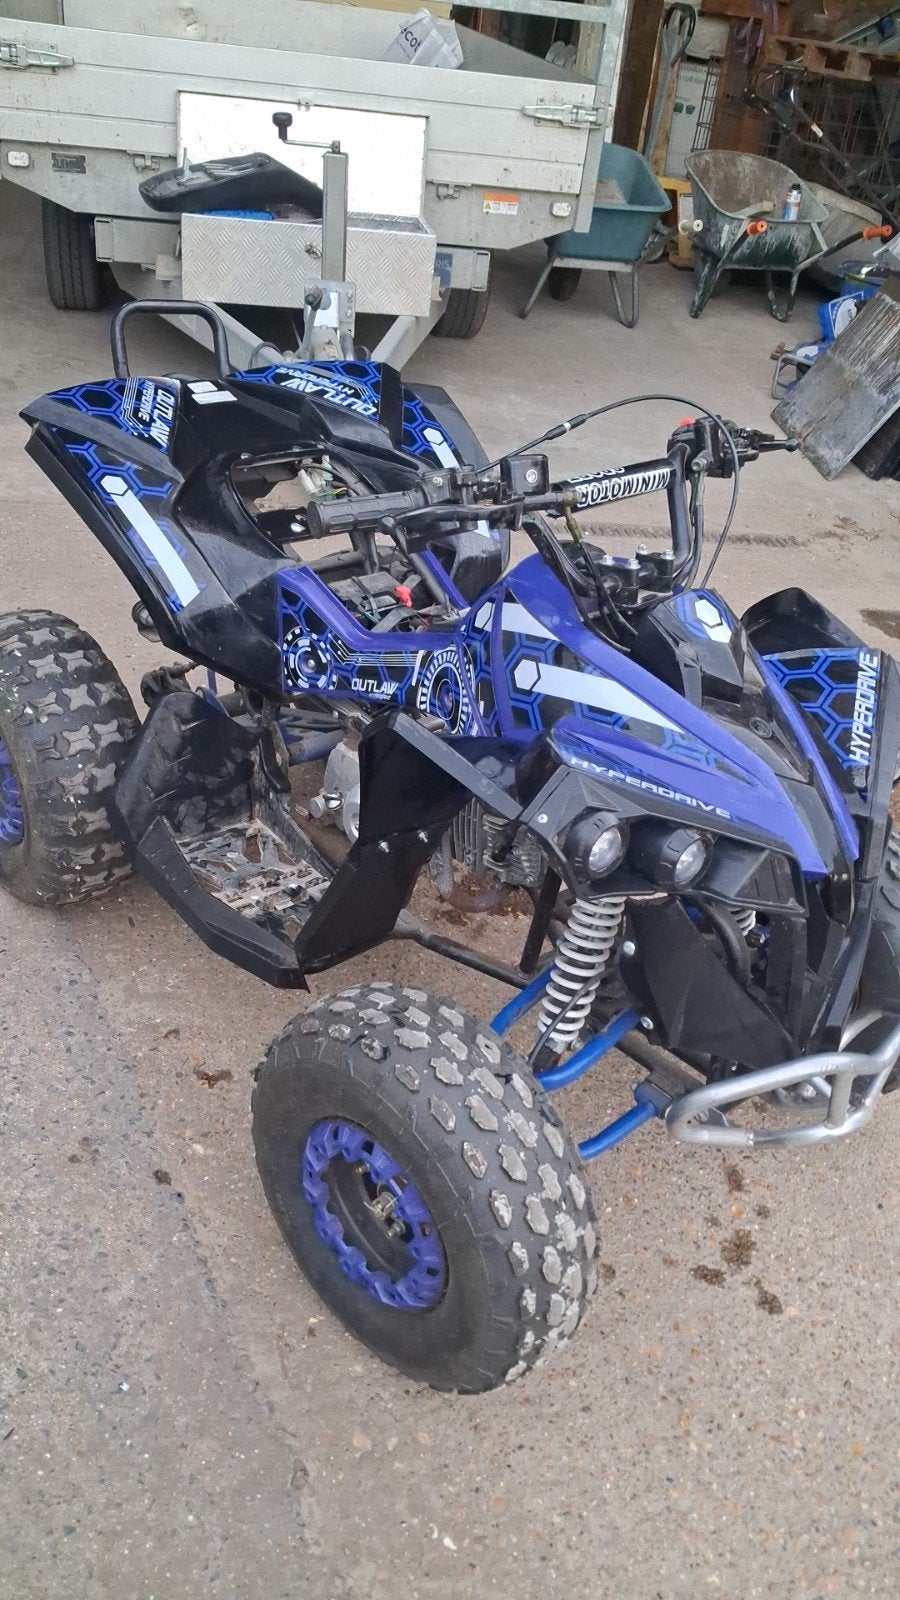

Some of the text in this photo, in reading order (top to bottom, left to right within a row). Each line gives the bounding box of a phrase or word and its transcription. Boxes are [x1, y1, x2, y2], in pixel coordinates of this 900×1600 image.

[275, 366, 355, 395] HYPERDRIVE
[280, 378, 377, 415] OUTLAW
[149, 388, 175, 448] OUTLAW
[351, 677, 399, 695] OUTLAW
[849, 651, 878, 766] HYPERDRIVE
[570, 757, 732, 819] HYPERDRIVE
